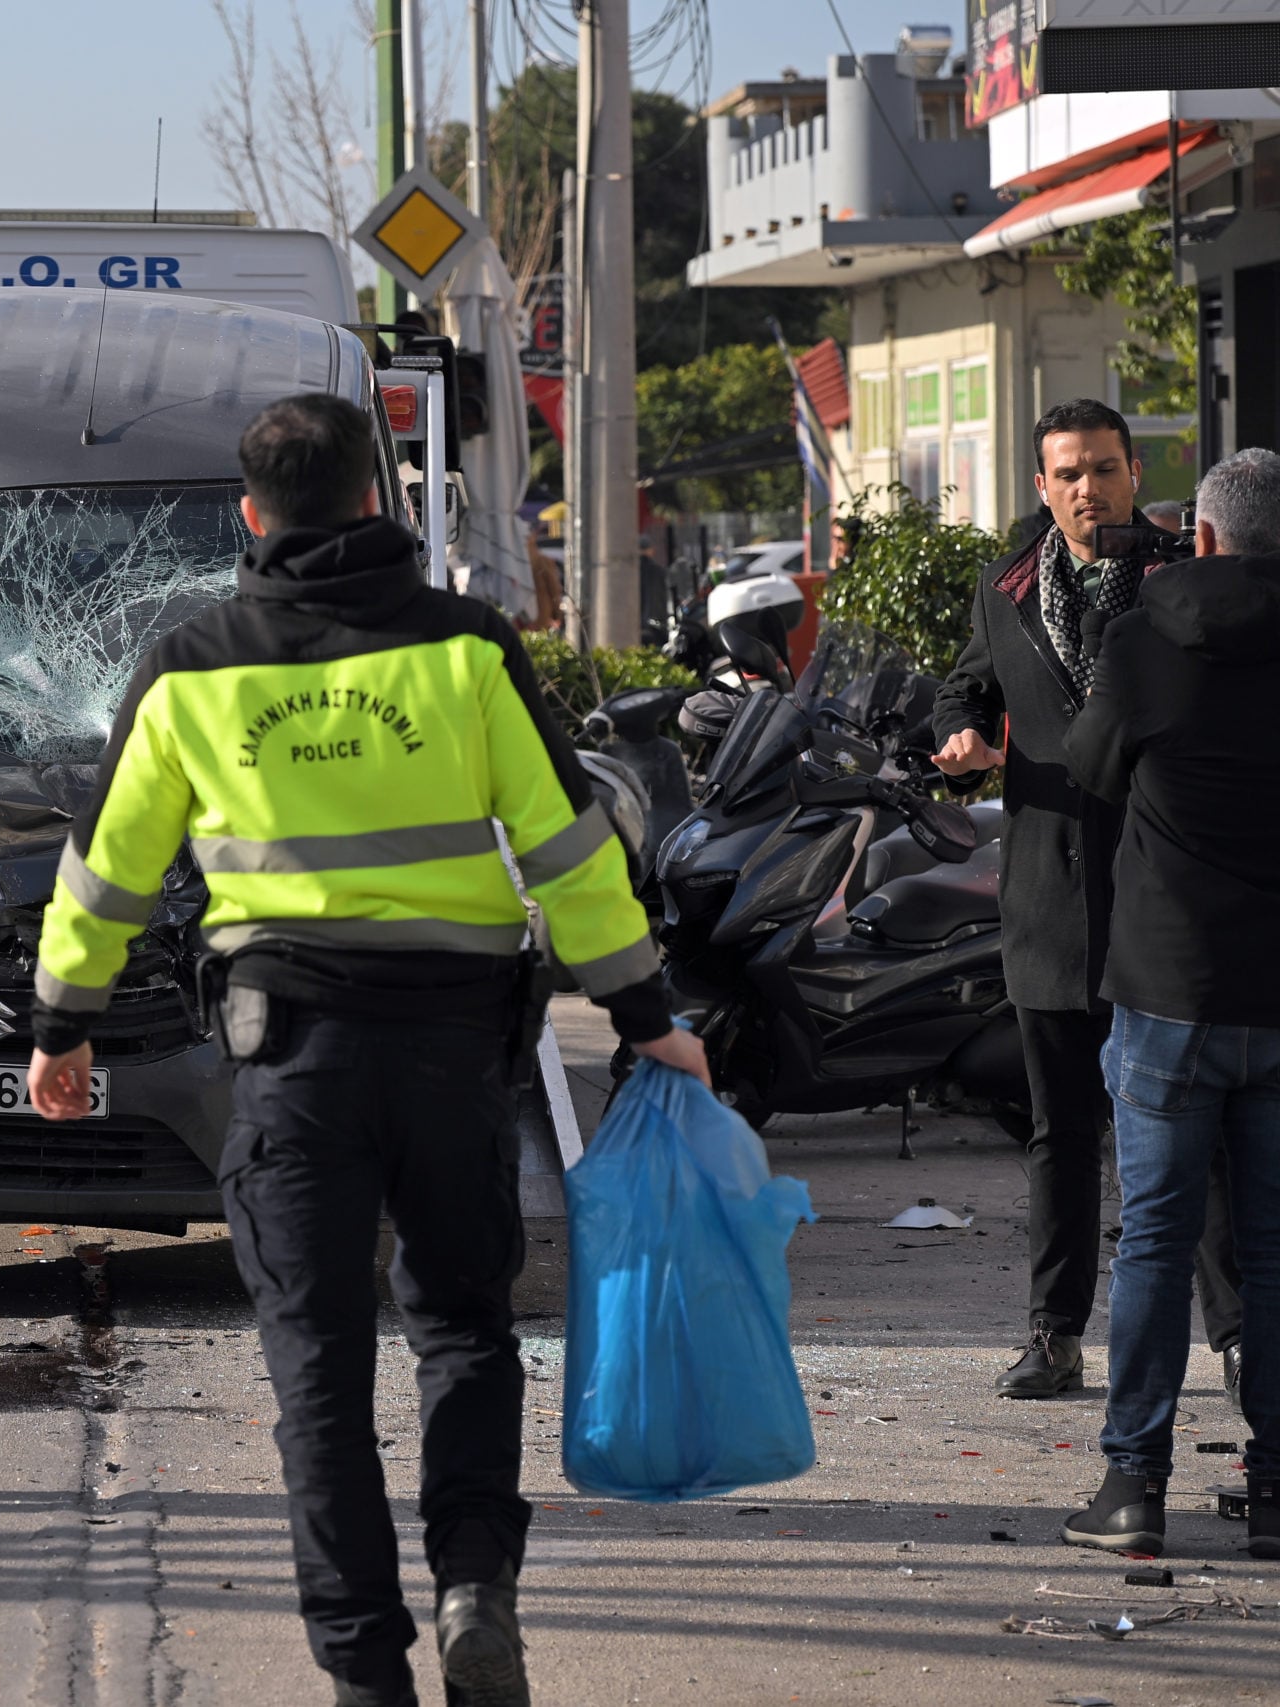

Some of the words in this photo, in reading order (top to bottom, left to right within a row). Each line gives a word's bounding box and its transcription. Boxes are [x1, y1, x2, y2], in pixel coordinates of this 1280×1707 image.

[98, 256, 183, 289] GR
[239, 691, 313, 768] ΕΛΛΗΝΙΚΗ
[319, 689, 424, 755] ΑΣΤΥΝΟΜΙΑ
[291, 738, 363, 763] POLICE
